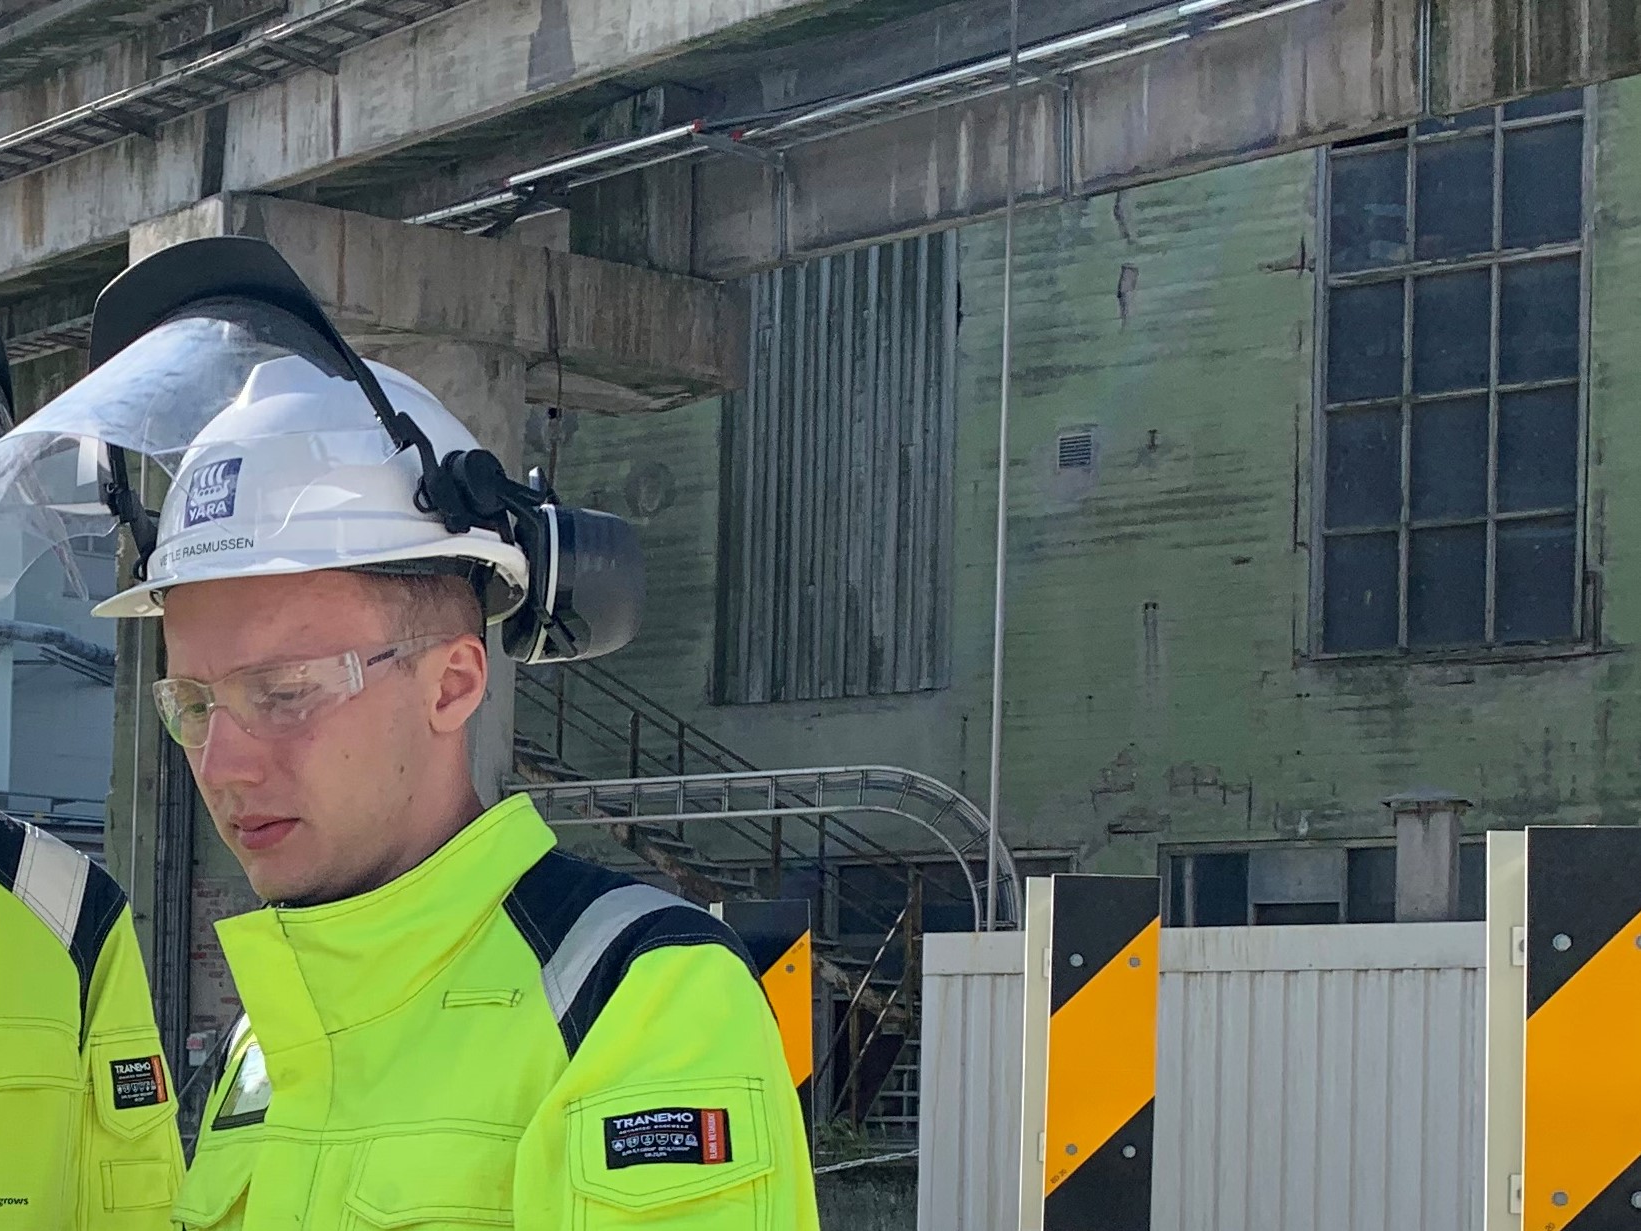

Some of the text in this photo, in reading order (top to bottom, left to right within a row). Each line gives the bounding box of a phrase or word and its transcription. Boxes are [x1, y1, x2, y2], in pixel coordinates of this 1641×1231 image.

[188, 501, 228, 521] YARA
[182, 537, 255, 558] RASMUSSEN
[115, 1061, 151, 1074] TRANEMO
[612, 1112, 694, 1130] TRANEMO
